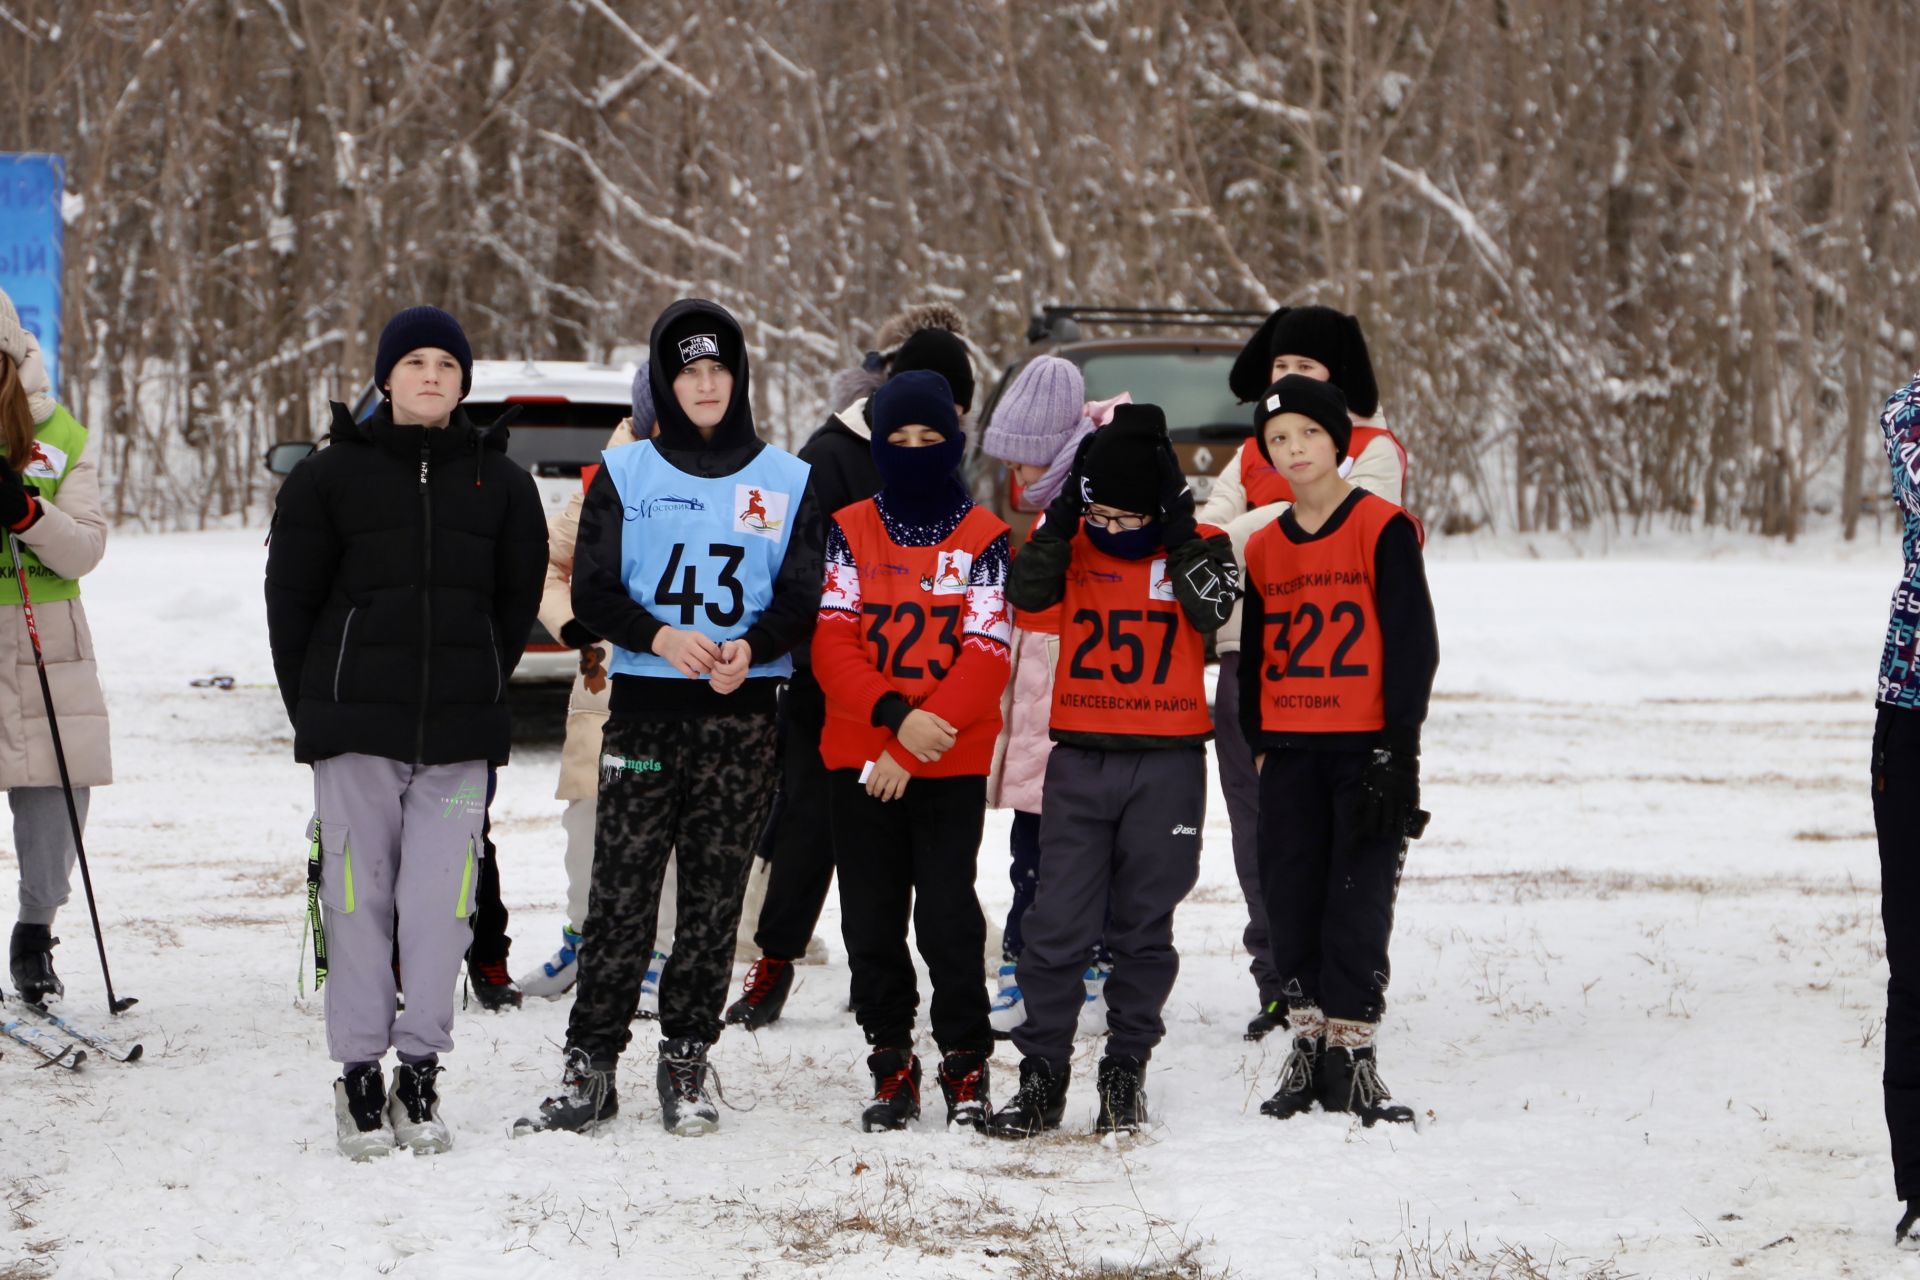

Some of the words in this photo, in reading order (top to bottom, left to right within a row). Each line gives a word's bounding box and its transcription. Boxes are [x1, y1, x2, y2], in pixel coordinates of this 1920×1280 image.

[682, 341, 705, 354] NORTH
[690, 337, 704, 345] THE
[690, 348, 706, 357] FACE
[654, 543, 746, 627] 43
[863, 601, 961, 681] 323
[1070, 608, 1179, 684] 257
[1264, 601, 1369, 682] 322
[1155, 696, 1198, 712] РАЙОН
